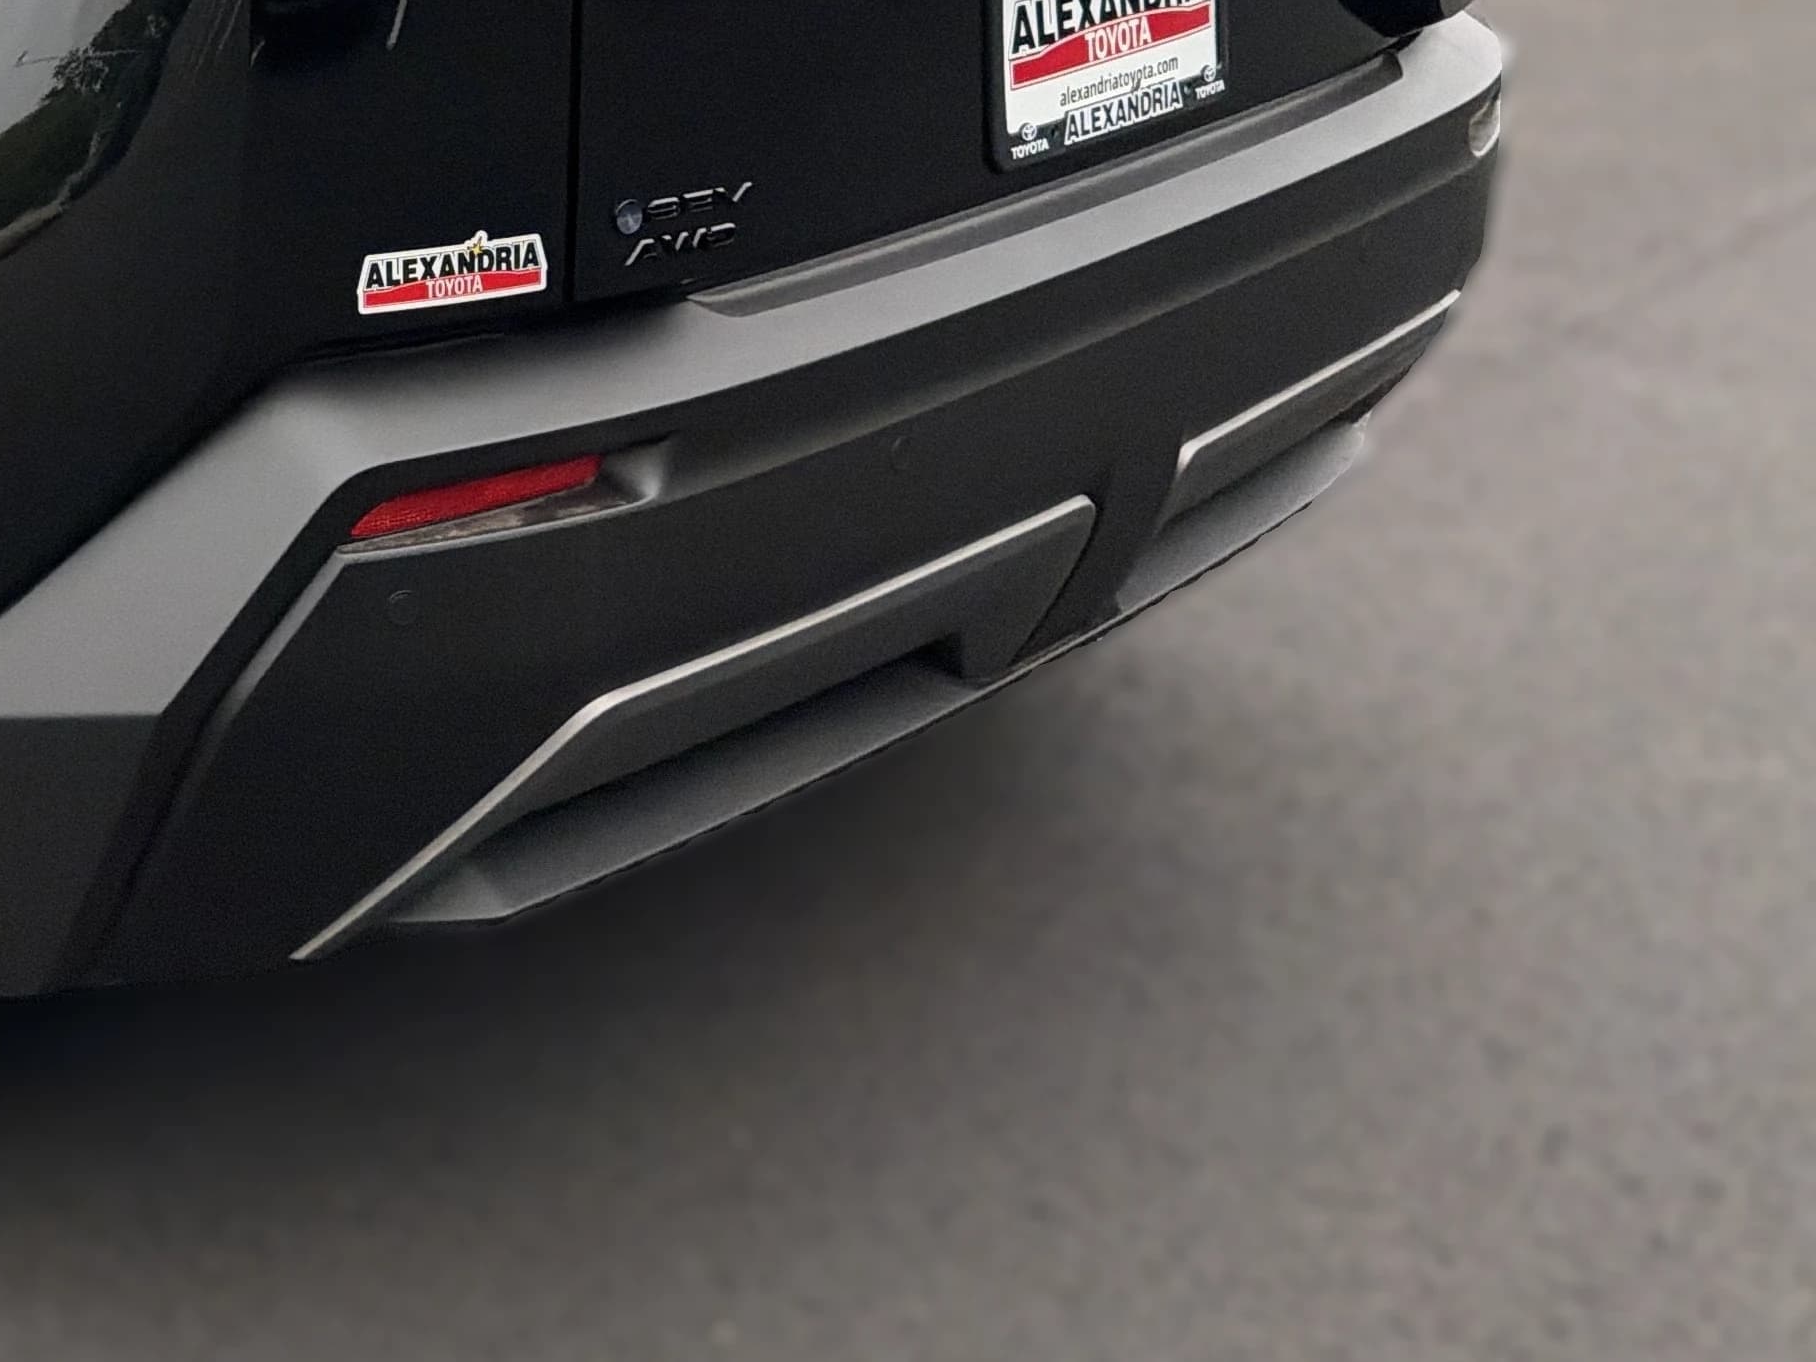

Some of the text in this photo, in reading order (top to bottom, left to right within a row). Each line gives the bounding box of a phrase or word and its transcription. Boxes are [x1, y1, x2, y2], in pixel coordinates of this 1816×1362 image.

[1085, 17, 1152, 63] TOYOTA
[1059, 56, 1179, 107] alexandriatoyota.com
[1065, 84, 1182, 143] ALEXANDRIA
[1011, 137, 1050, 160] TOYOTA
[365, 241, 540, 290] ALEXANDRIA
[426, 275, 484, 299] TOYOTA
